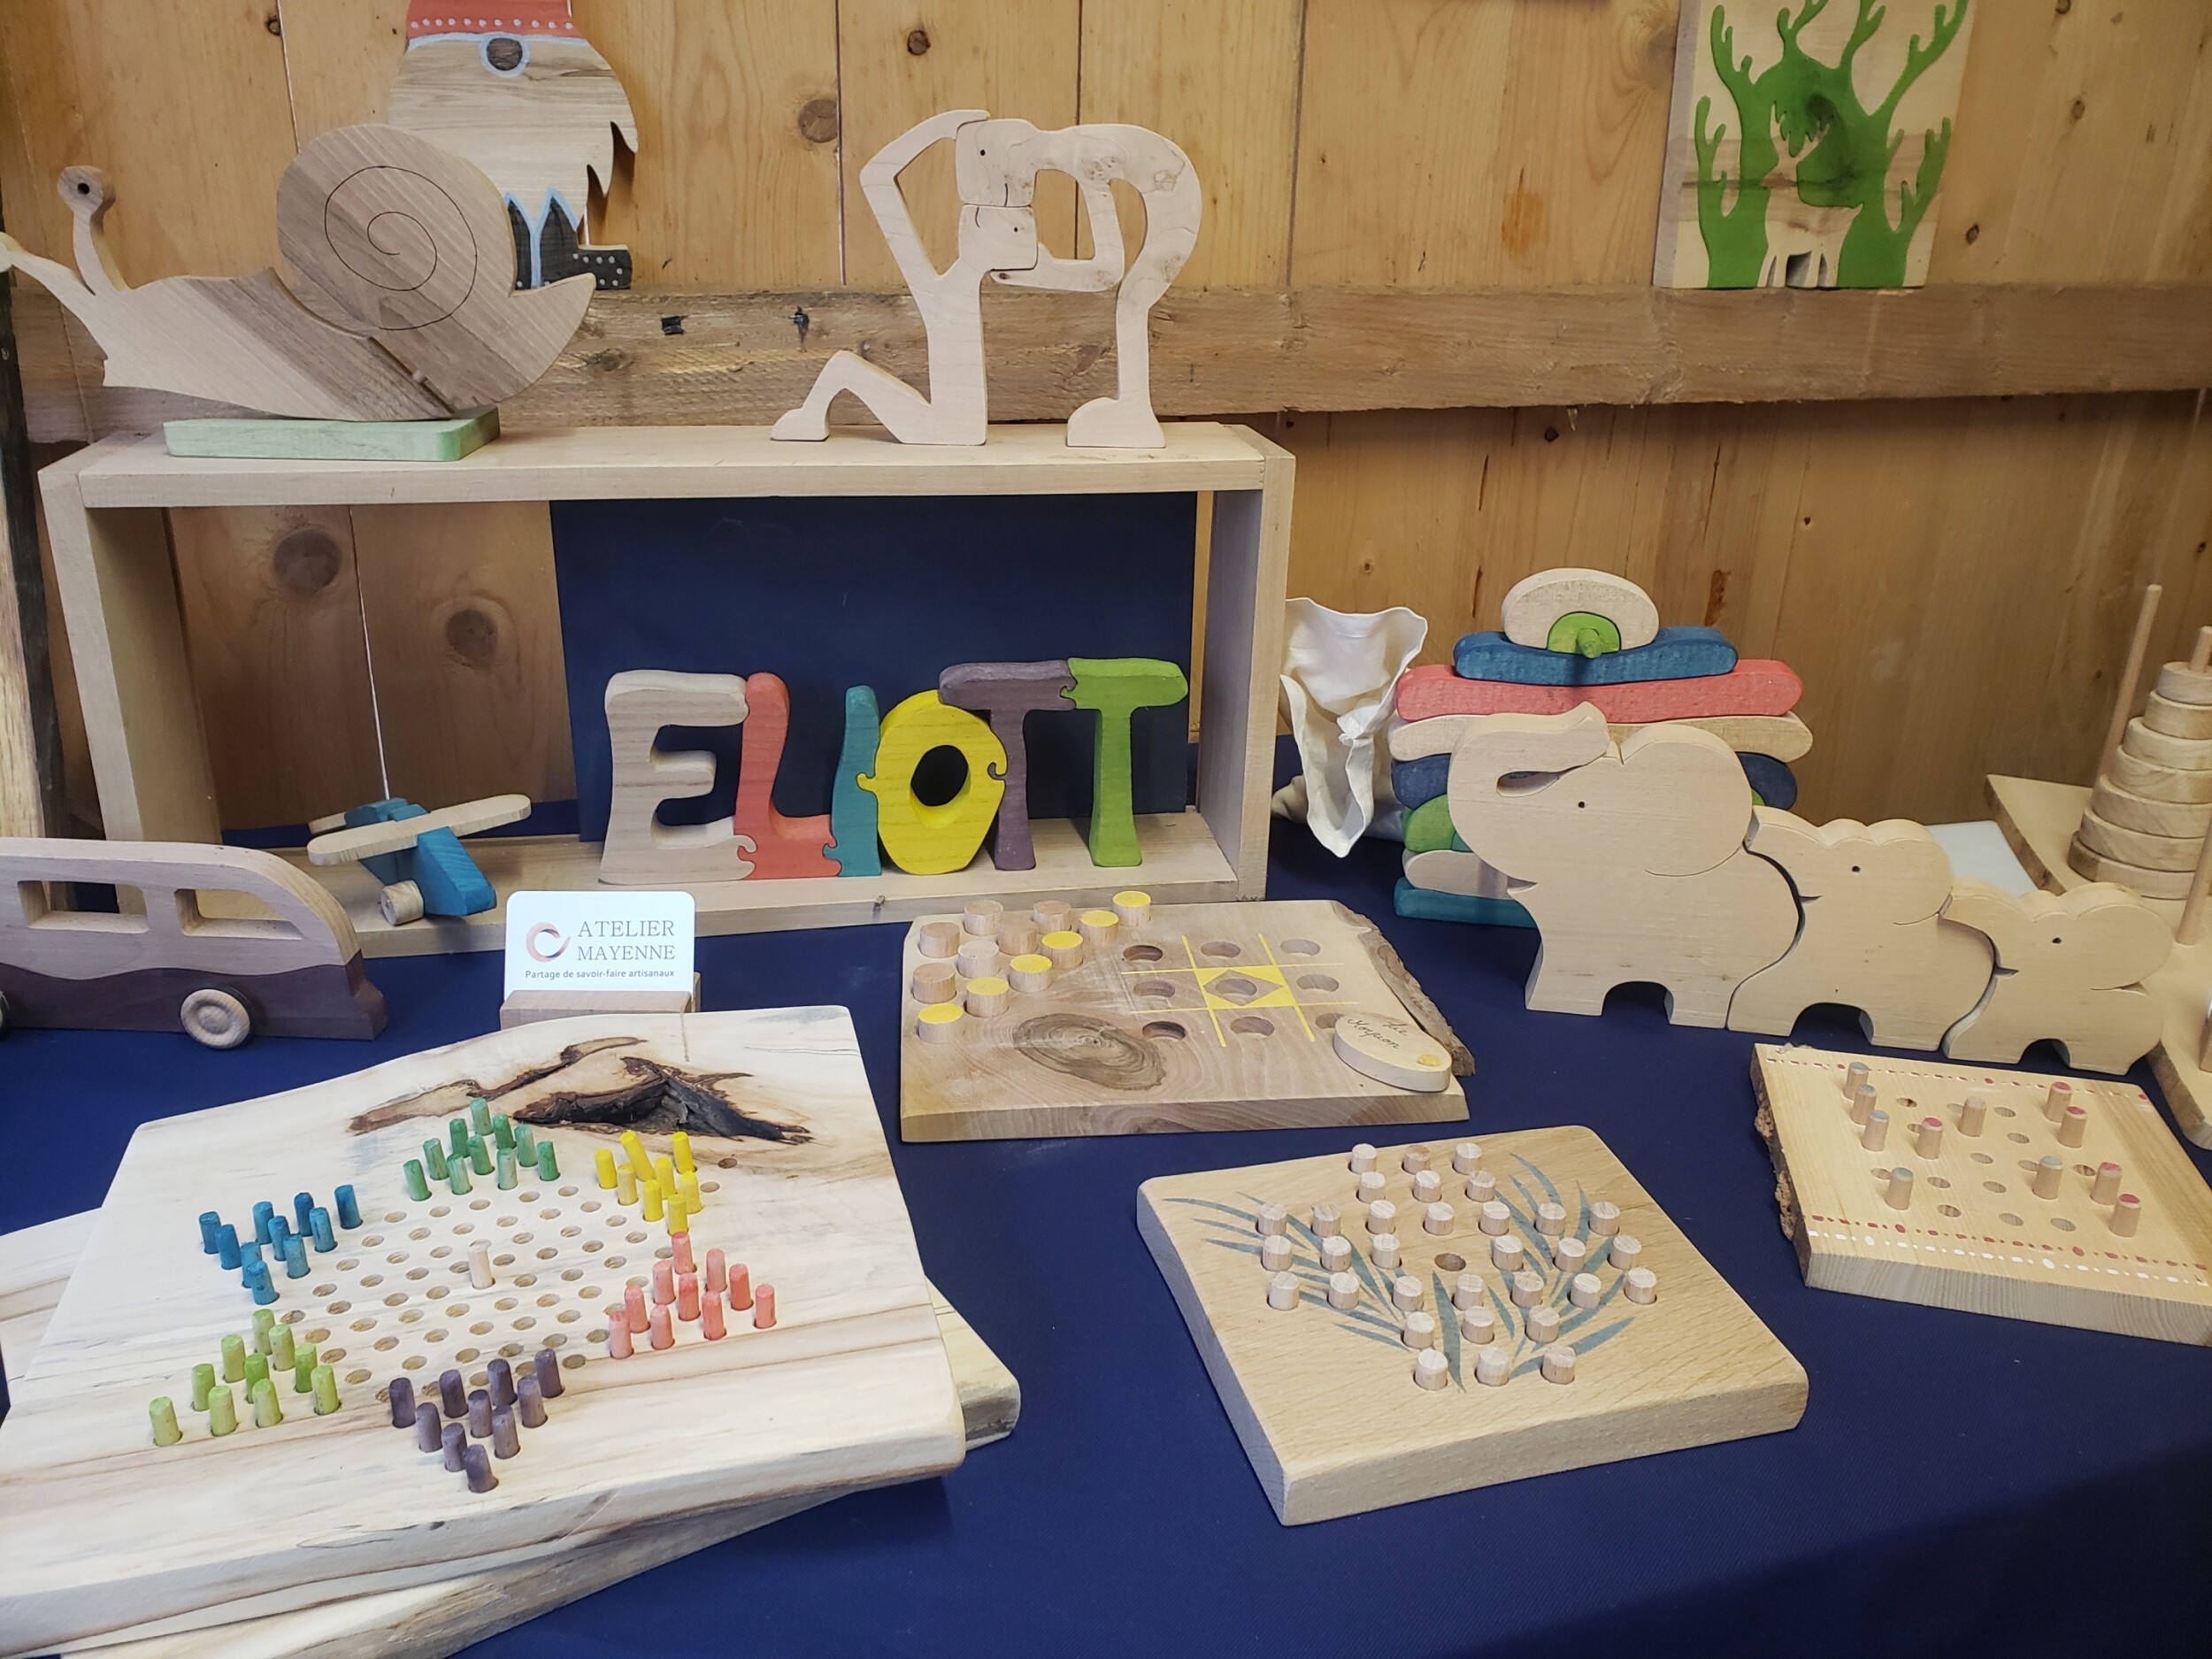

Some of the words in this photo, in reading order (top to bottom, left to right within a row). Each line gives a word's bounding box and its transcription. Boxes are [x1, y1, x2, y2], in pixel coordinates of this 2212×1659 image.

[598, 657, 1188, 885] ELIOTT
[577, 919, 675, 938] ATELIER
[577, 944, 676, 961] MAYENNE
[525, 970, 560, 980] Partage
[563, 970, 574, 979] de
[576, 969, 626, 979] savoir-faire
[628, 969, 675, 978] artisanaux
